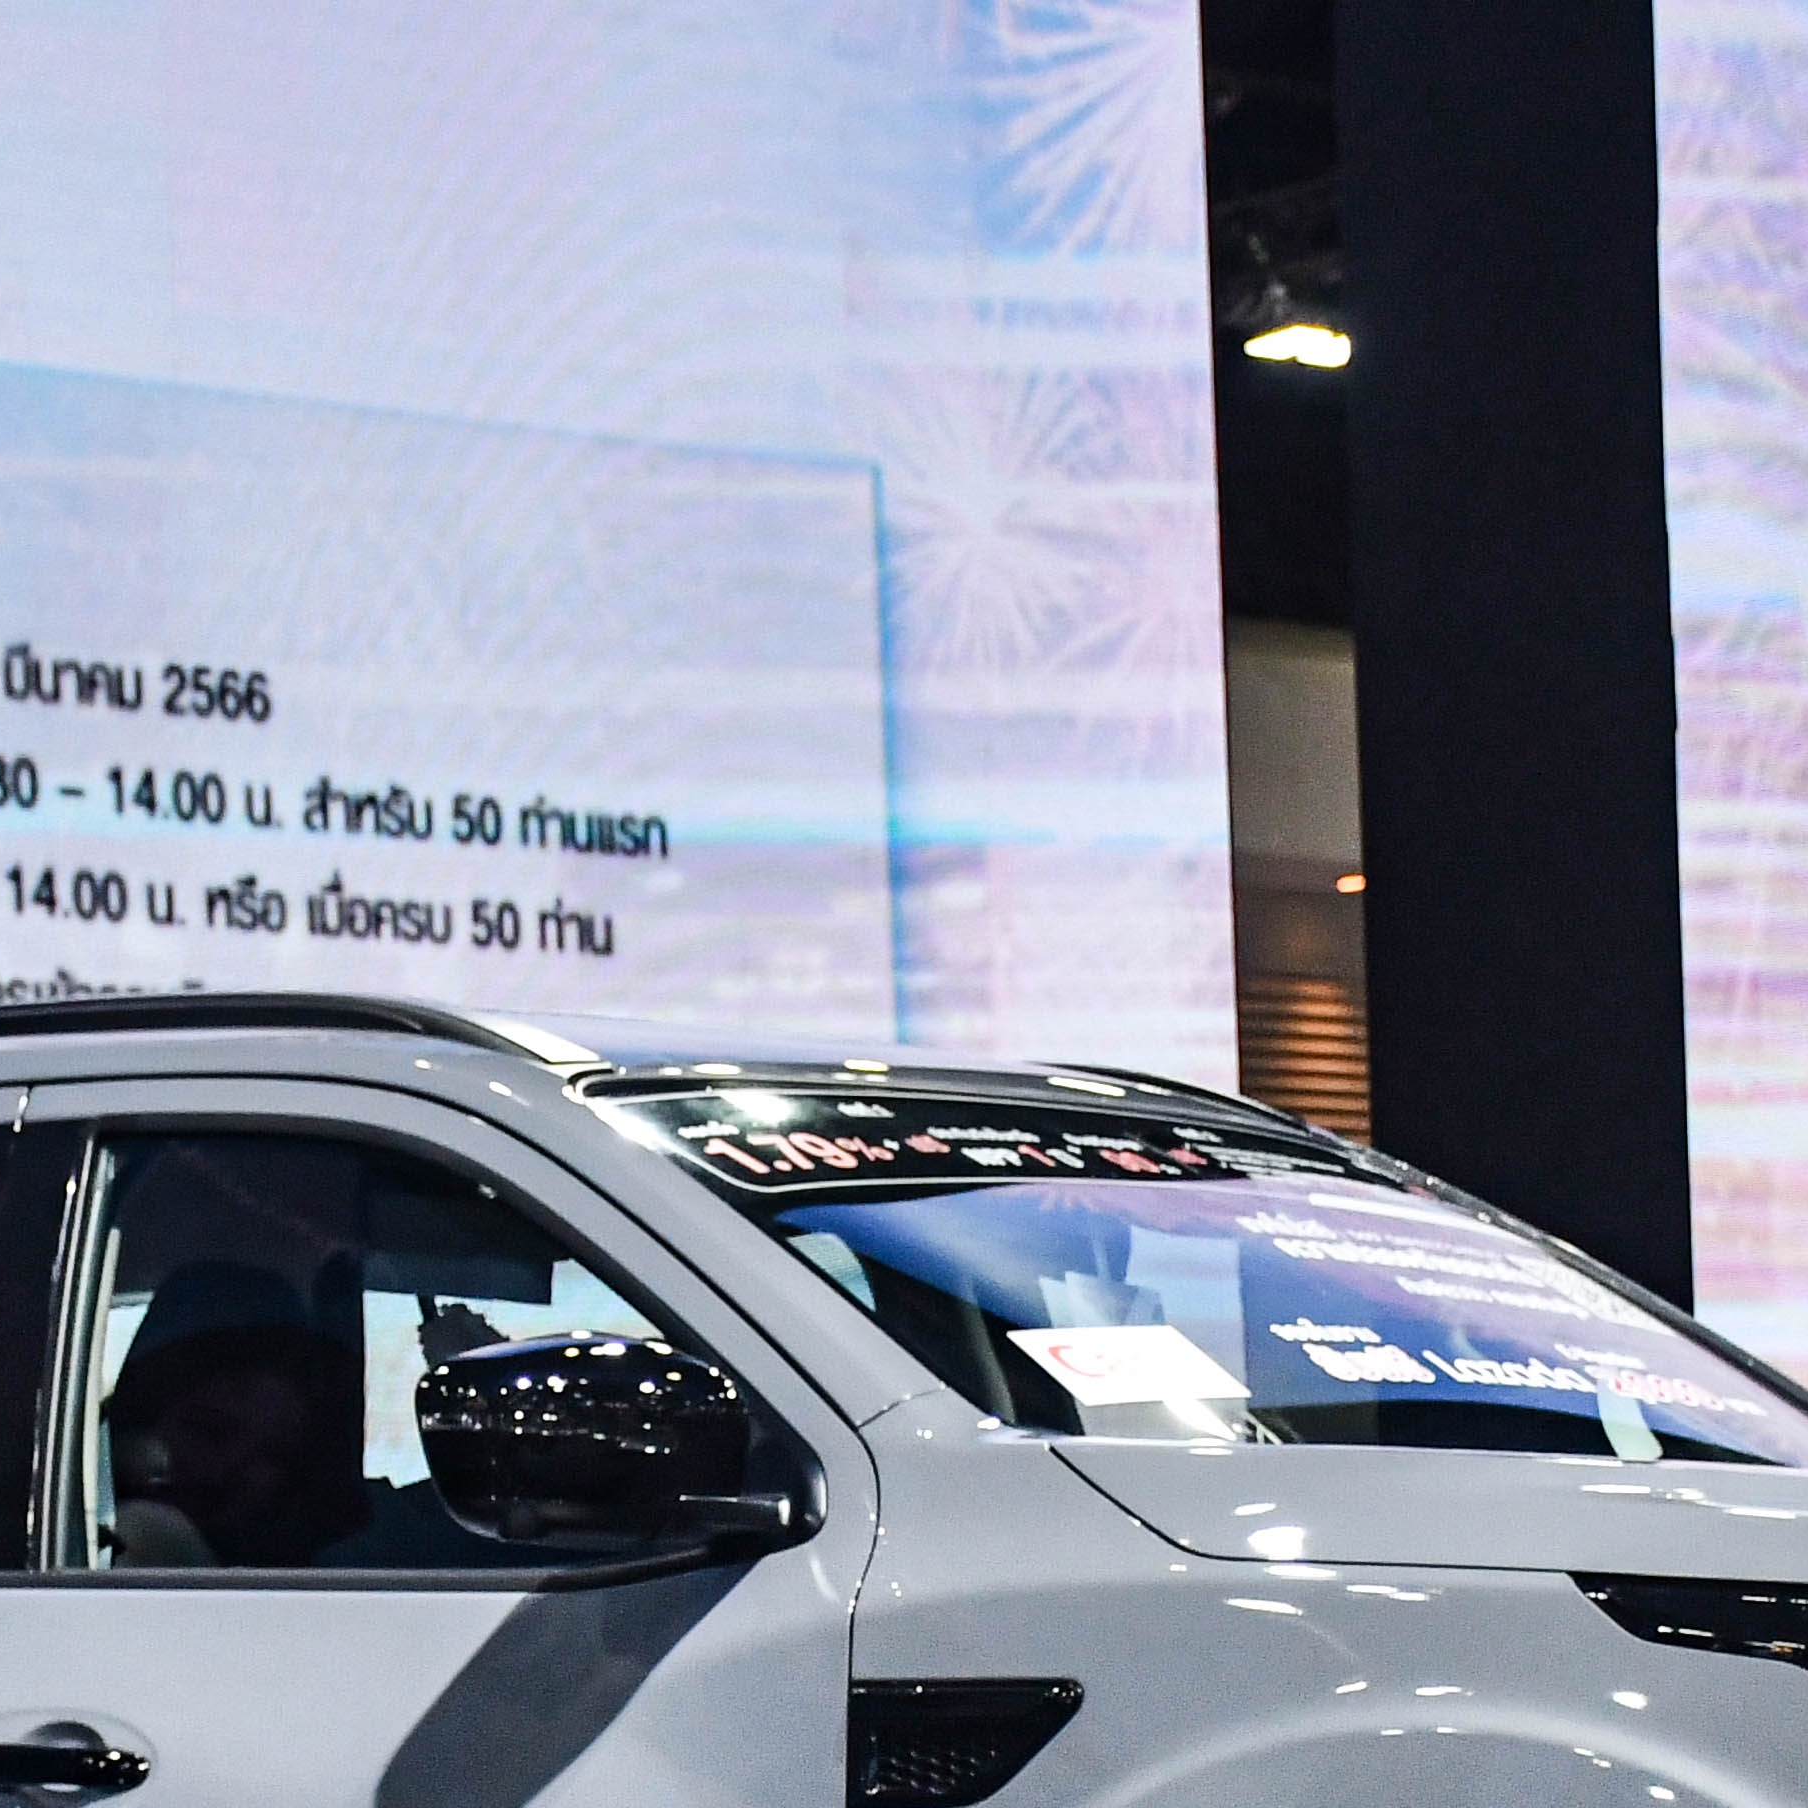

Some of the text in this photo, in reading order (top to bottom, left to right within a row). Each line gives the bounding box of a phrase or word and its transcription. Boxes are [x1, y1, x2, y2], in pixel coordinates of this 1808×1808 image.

[3, 641, 143, 711] มีนาคม
[162, 662, 272, 721] 2566
[107, 765, 226, 825] 14.00
[303, 775, 433, 841] สำหรับ
[451, 795, 503, 846] 50
[520, 791, 669, 858] ท่านแรก
[8, 863, 129, 922] 14.00
[206, 875, 287, 935] หรือ
[305, 868, 452, 945] เมื่อครบ
[471, 900, 521, 950] 50
[539, 898, 615, 955] ท่าน
